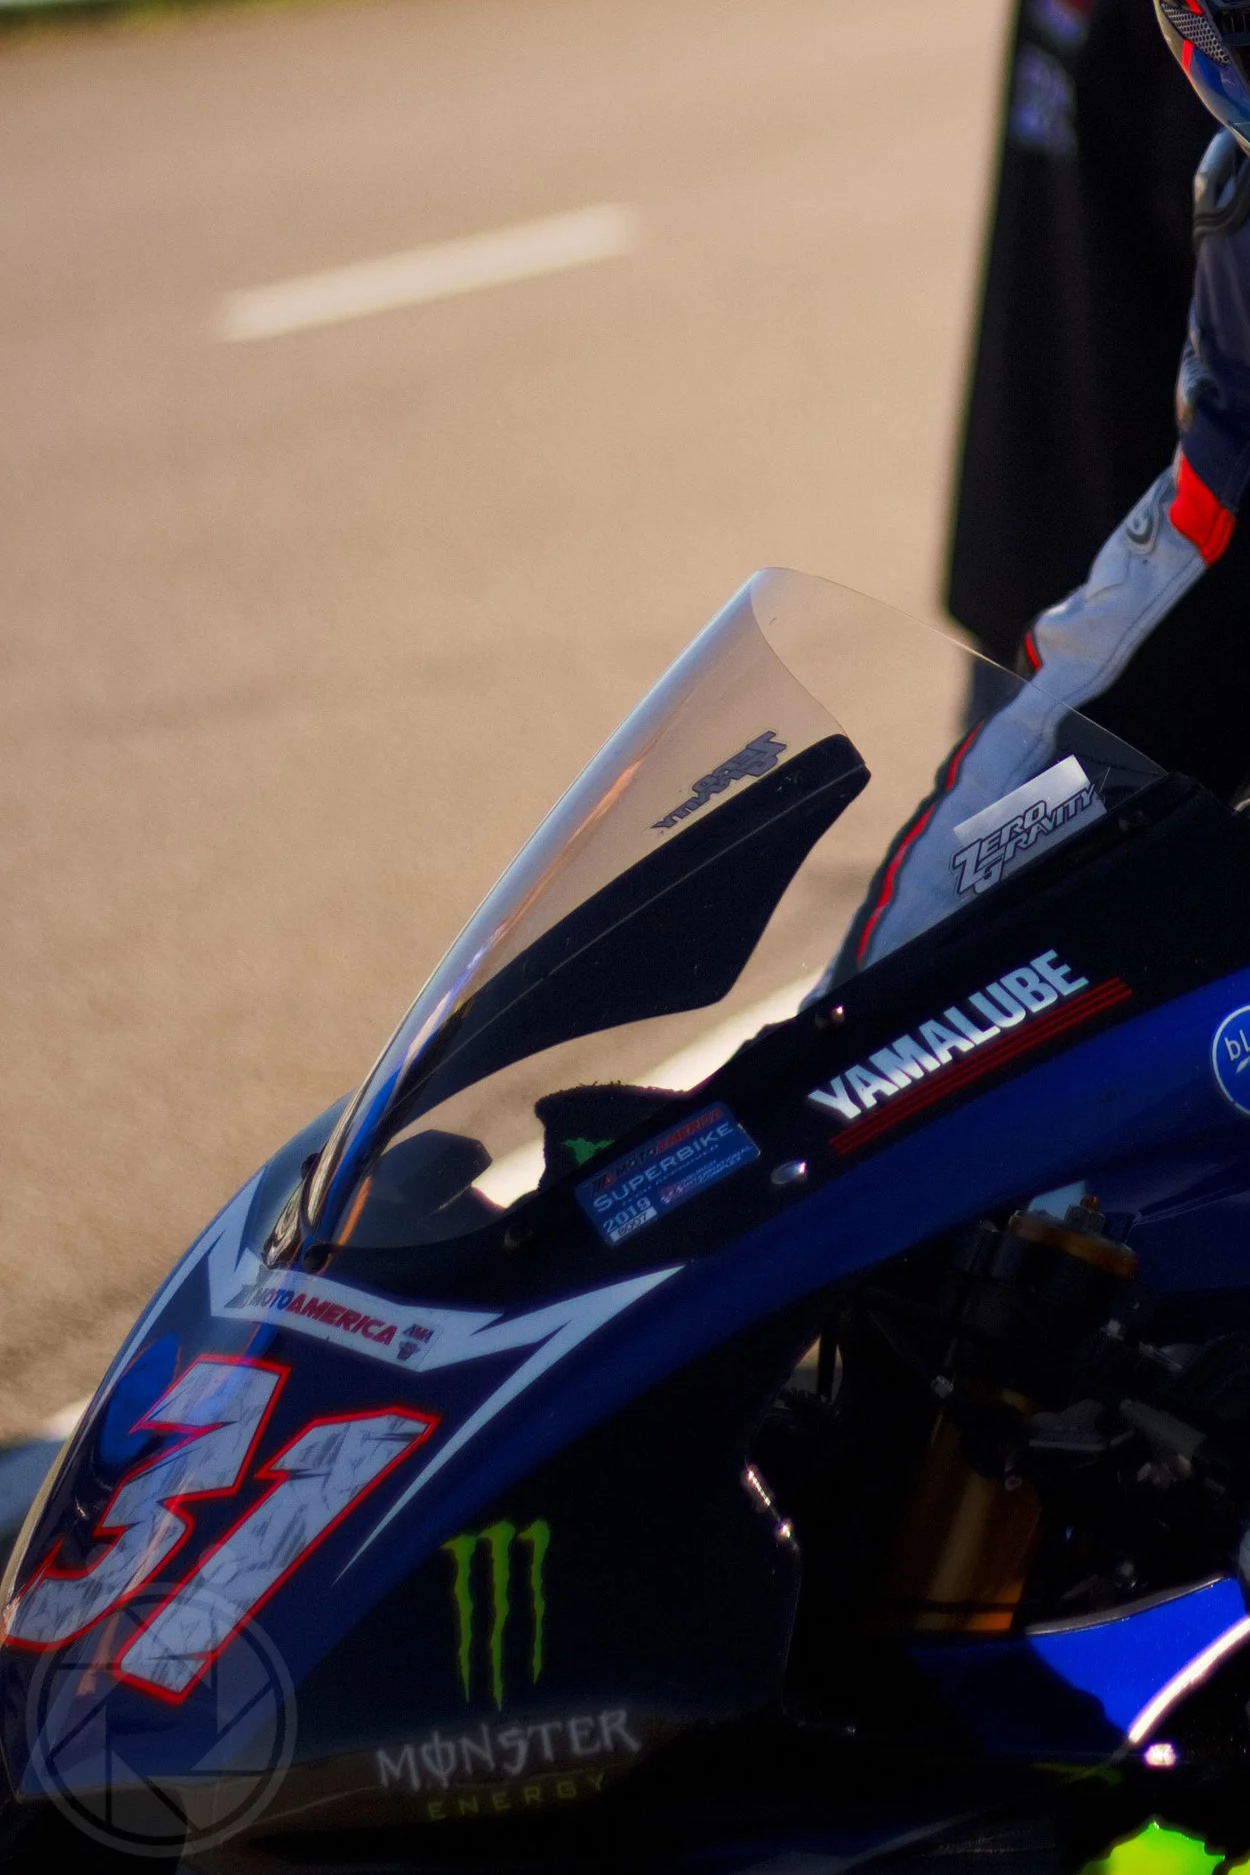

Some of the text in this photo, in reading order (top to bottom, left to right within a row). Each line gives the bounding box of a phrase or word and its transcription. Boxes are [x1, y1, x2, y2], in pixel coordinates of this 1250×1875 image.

[952, 800, 1047, 894] ZERO
[973, 783, 1096, 894] GRAVITY
[808, 948, 1090, 1120] YAMALUBE
[593, 1120, 734, 1213] SUPERBIKE
[602, 1196, 652, 1234] 2019
[3, 1354, 442, 1706] 31
[375, 1708, 644, 1794] MONSTER
[427, 1773, 606, 1821] ENERGY
